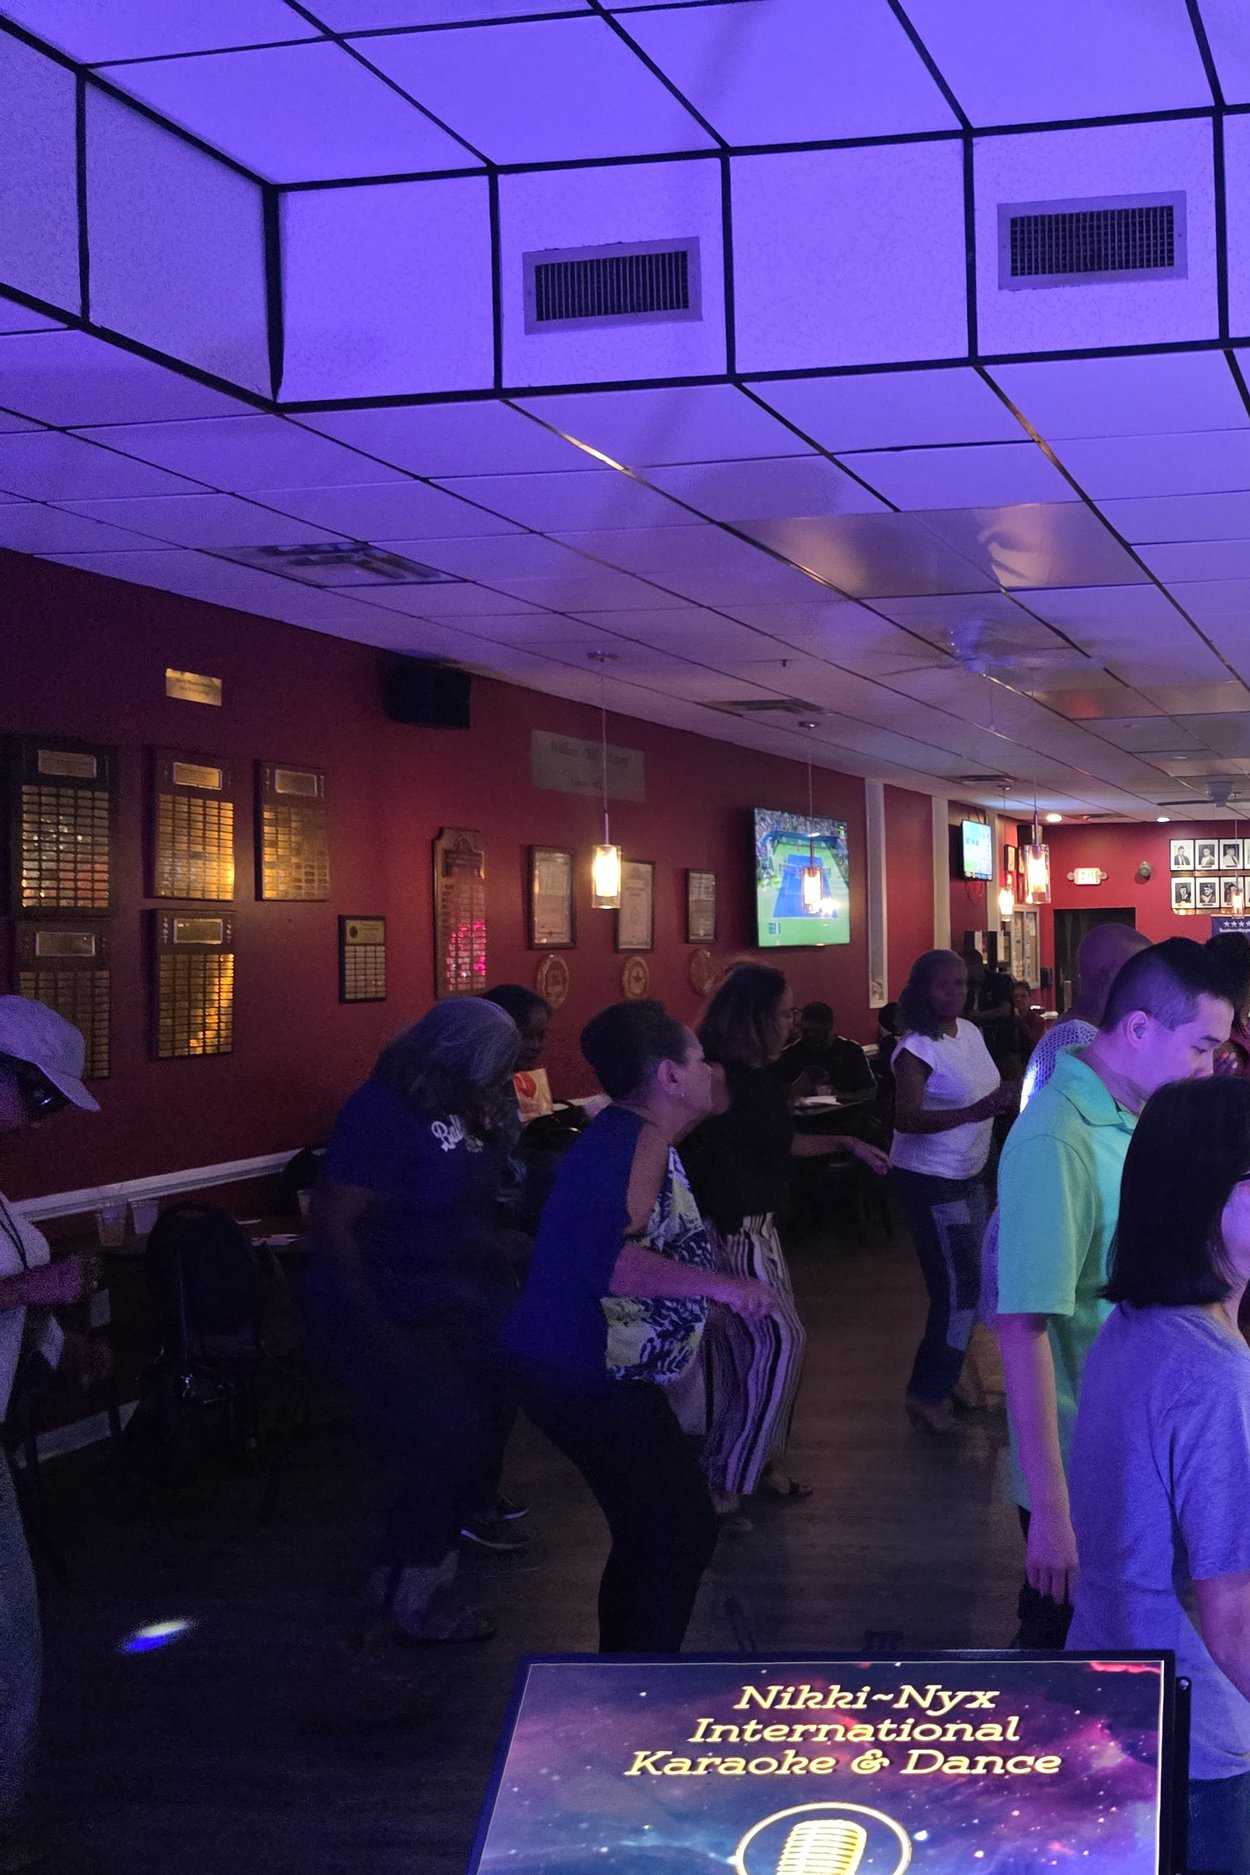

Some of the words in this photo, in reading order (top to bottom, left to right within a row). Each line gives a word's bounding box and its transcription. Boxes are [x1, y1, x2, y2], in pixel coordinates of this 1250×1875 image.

[732, 1684, 1000, 1716] Nikki~Nyx
[687, 1716, 1021, 1743] International
[624, 1750, 837, 1776] Karaoke
[850, 1748, 891, 1775] &
[899, 1749, 1062, 1775] Dance
